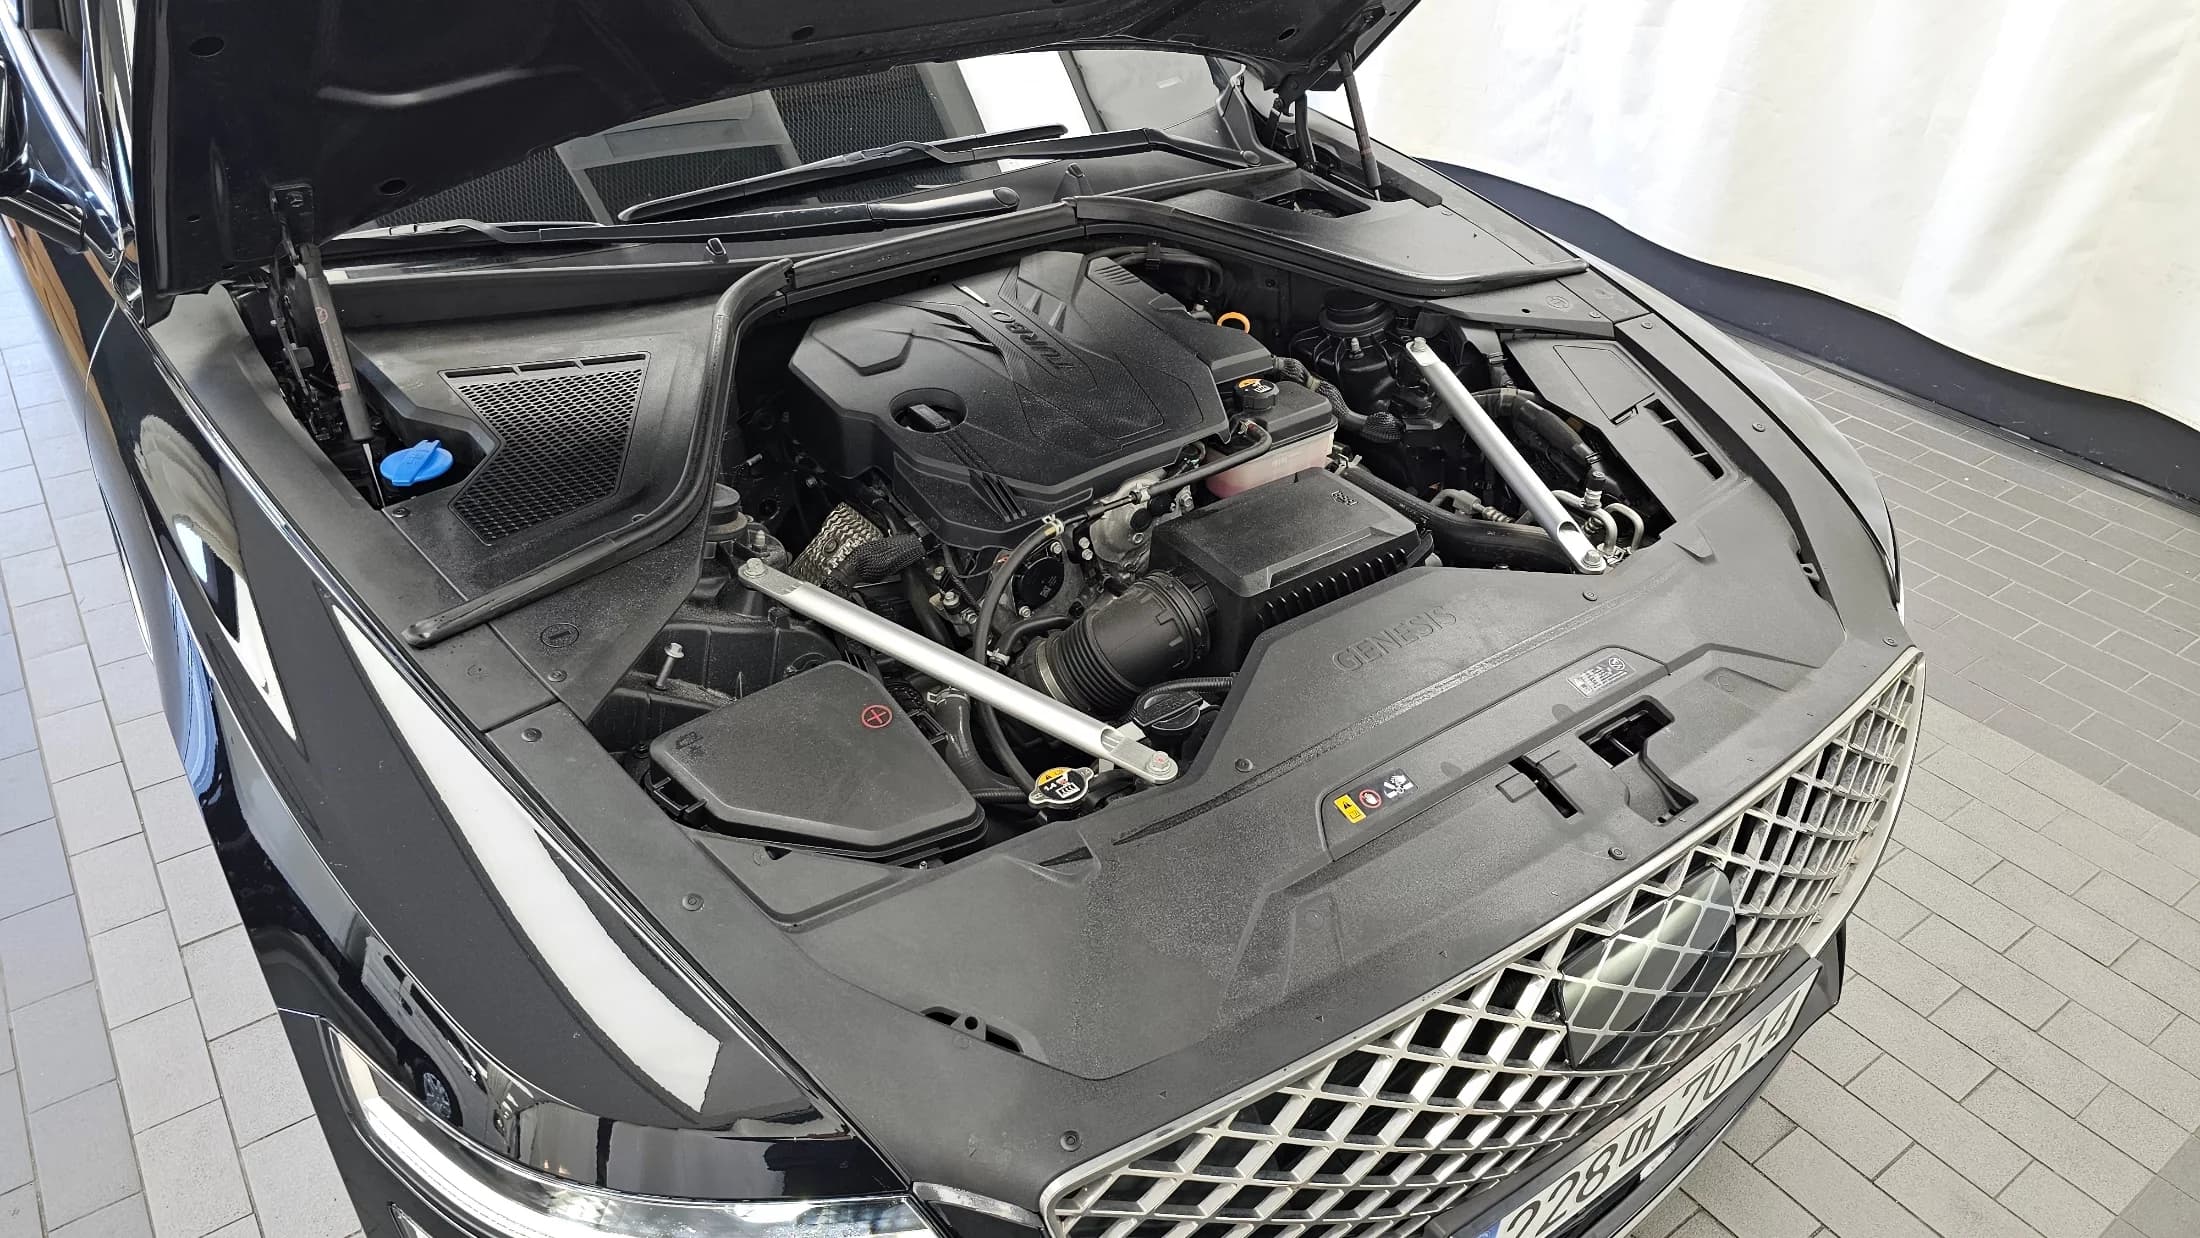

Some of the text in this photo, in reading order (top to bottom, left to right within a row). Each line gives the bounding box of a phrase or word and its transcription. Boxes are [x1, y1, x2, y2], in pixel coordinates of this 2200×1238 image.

[989, 309, 1076, 369] TURBO
[1332, 606, 1457, 671] GENESIS
[1673, 989, 1801, 1129] 7014
